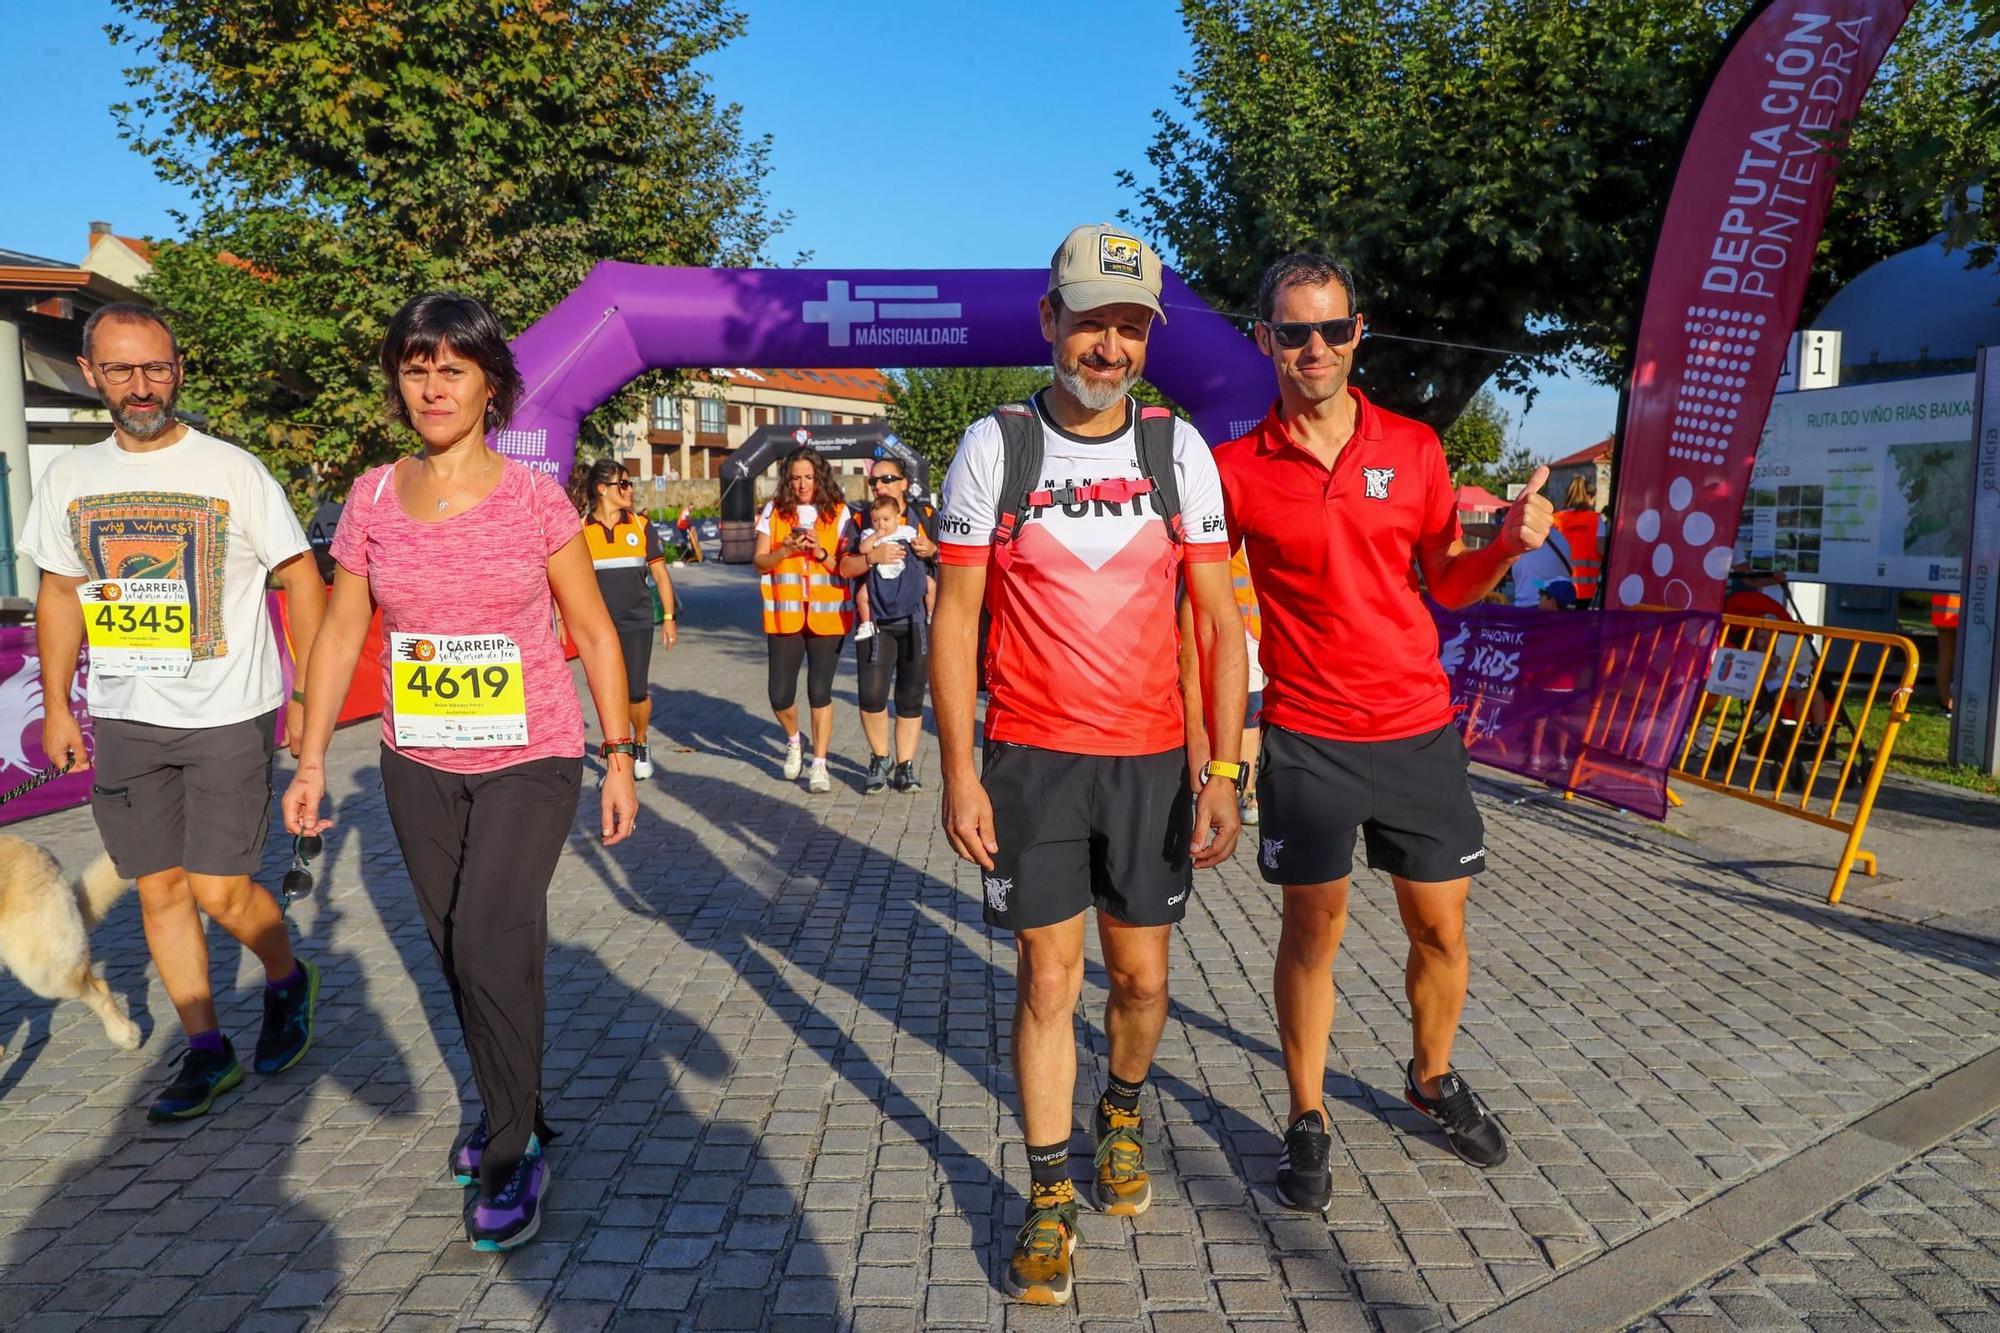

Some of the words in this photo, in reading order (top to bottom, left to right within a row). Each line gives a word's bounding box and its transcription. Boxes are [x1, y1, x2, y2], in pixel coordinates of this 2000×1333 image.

[1702, 12, 1831, 294] DEPUTACIÓN
[1740, 16, 1873, 298] PONTEVEDRA
[855, 324, 969, 346] MÁISIGUALDADE
[1813, 336, 1826, 375] i
[1807, 411, 1838, 428] RUTA
[1841, 410, 1859, 426] DO
[1862, 404, 1893, 424] VIÑO
[1896, 401, 1927, 421] RÍAS
[130, 582, 184, 593] CARREIRA
[95, 604, 185, 634] 4345
[446, 639, 515, 653] CARREIRA
[407, 665, 510, 699] 4619
